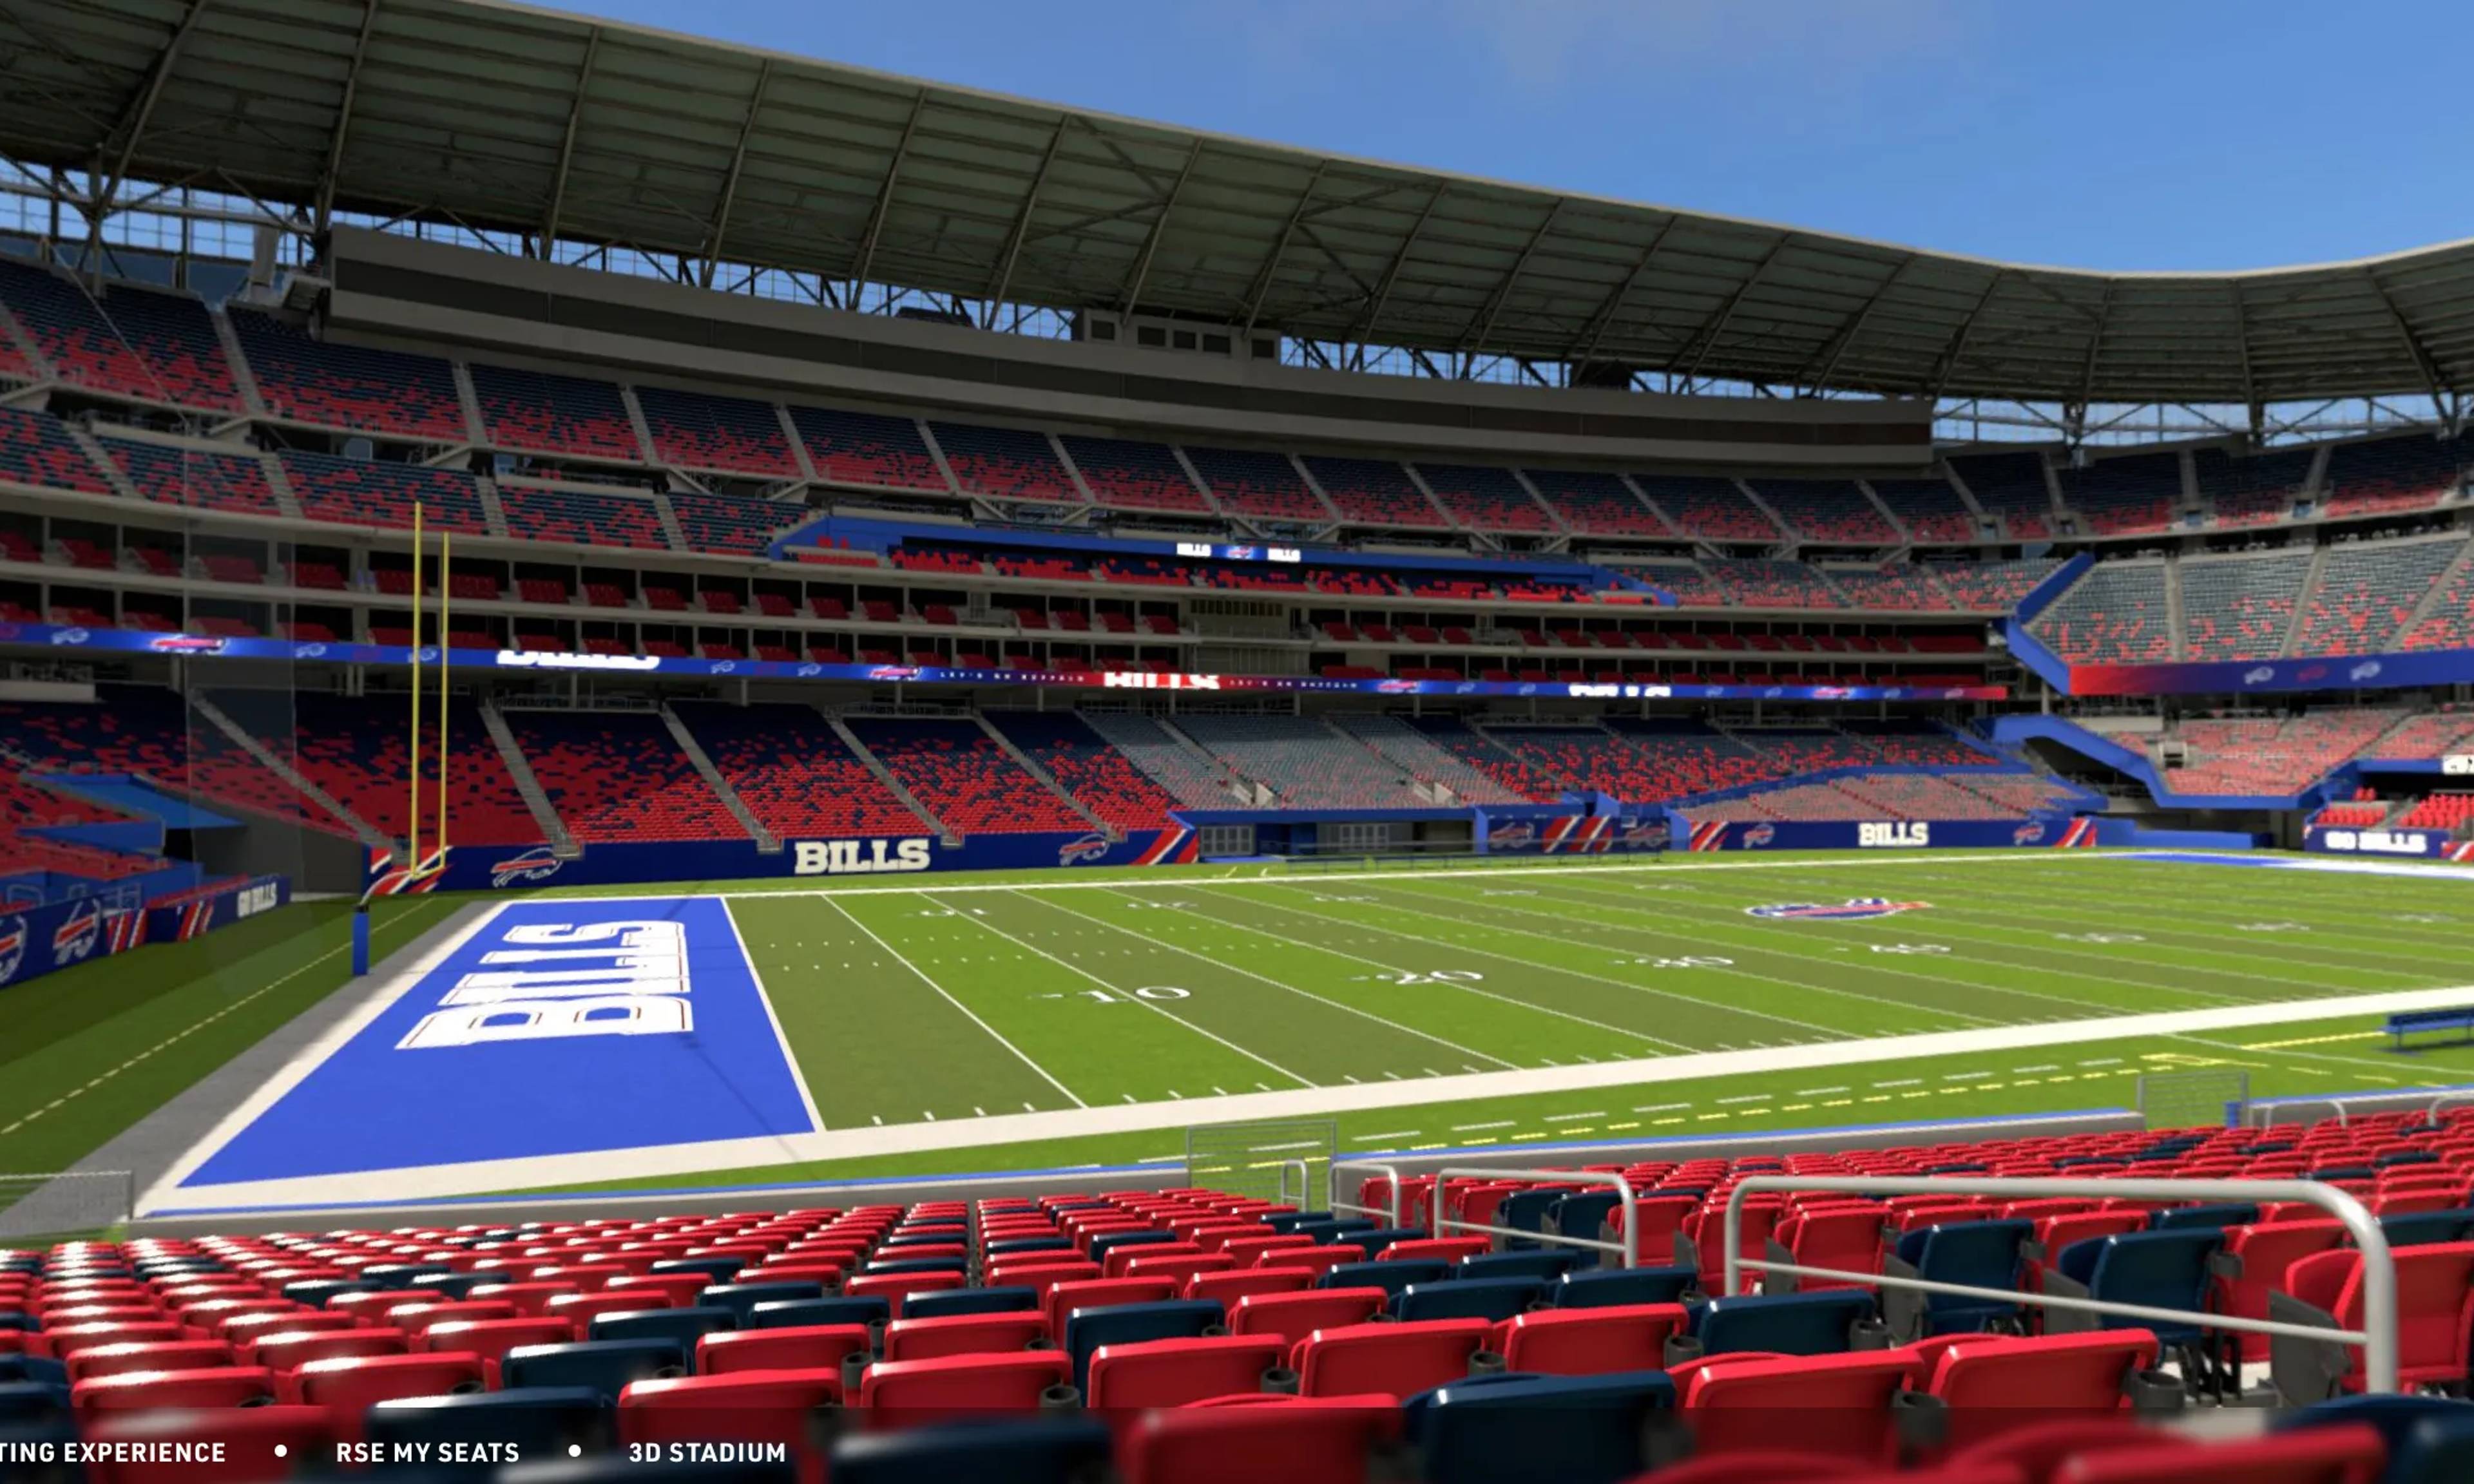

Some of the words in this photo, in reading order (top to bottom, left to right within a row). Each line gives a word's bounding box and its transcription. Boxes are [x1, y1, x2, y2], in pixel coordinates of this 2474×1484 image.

[1859, 823, 1929, 846] BILLS
[795, 839, 930, 874] BILLS
[394, 920, 693, 1049] BILLS
[1077, 986, 1191, 1003] 10
